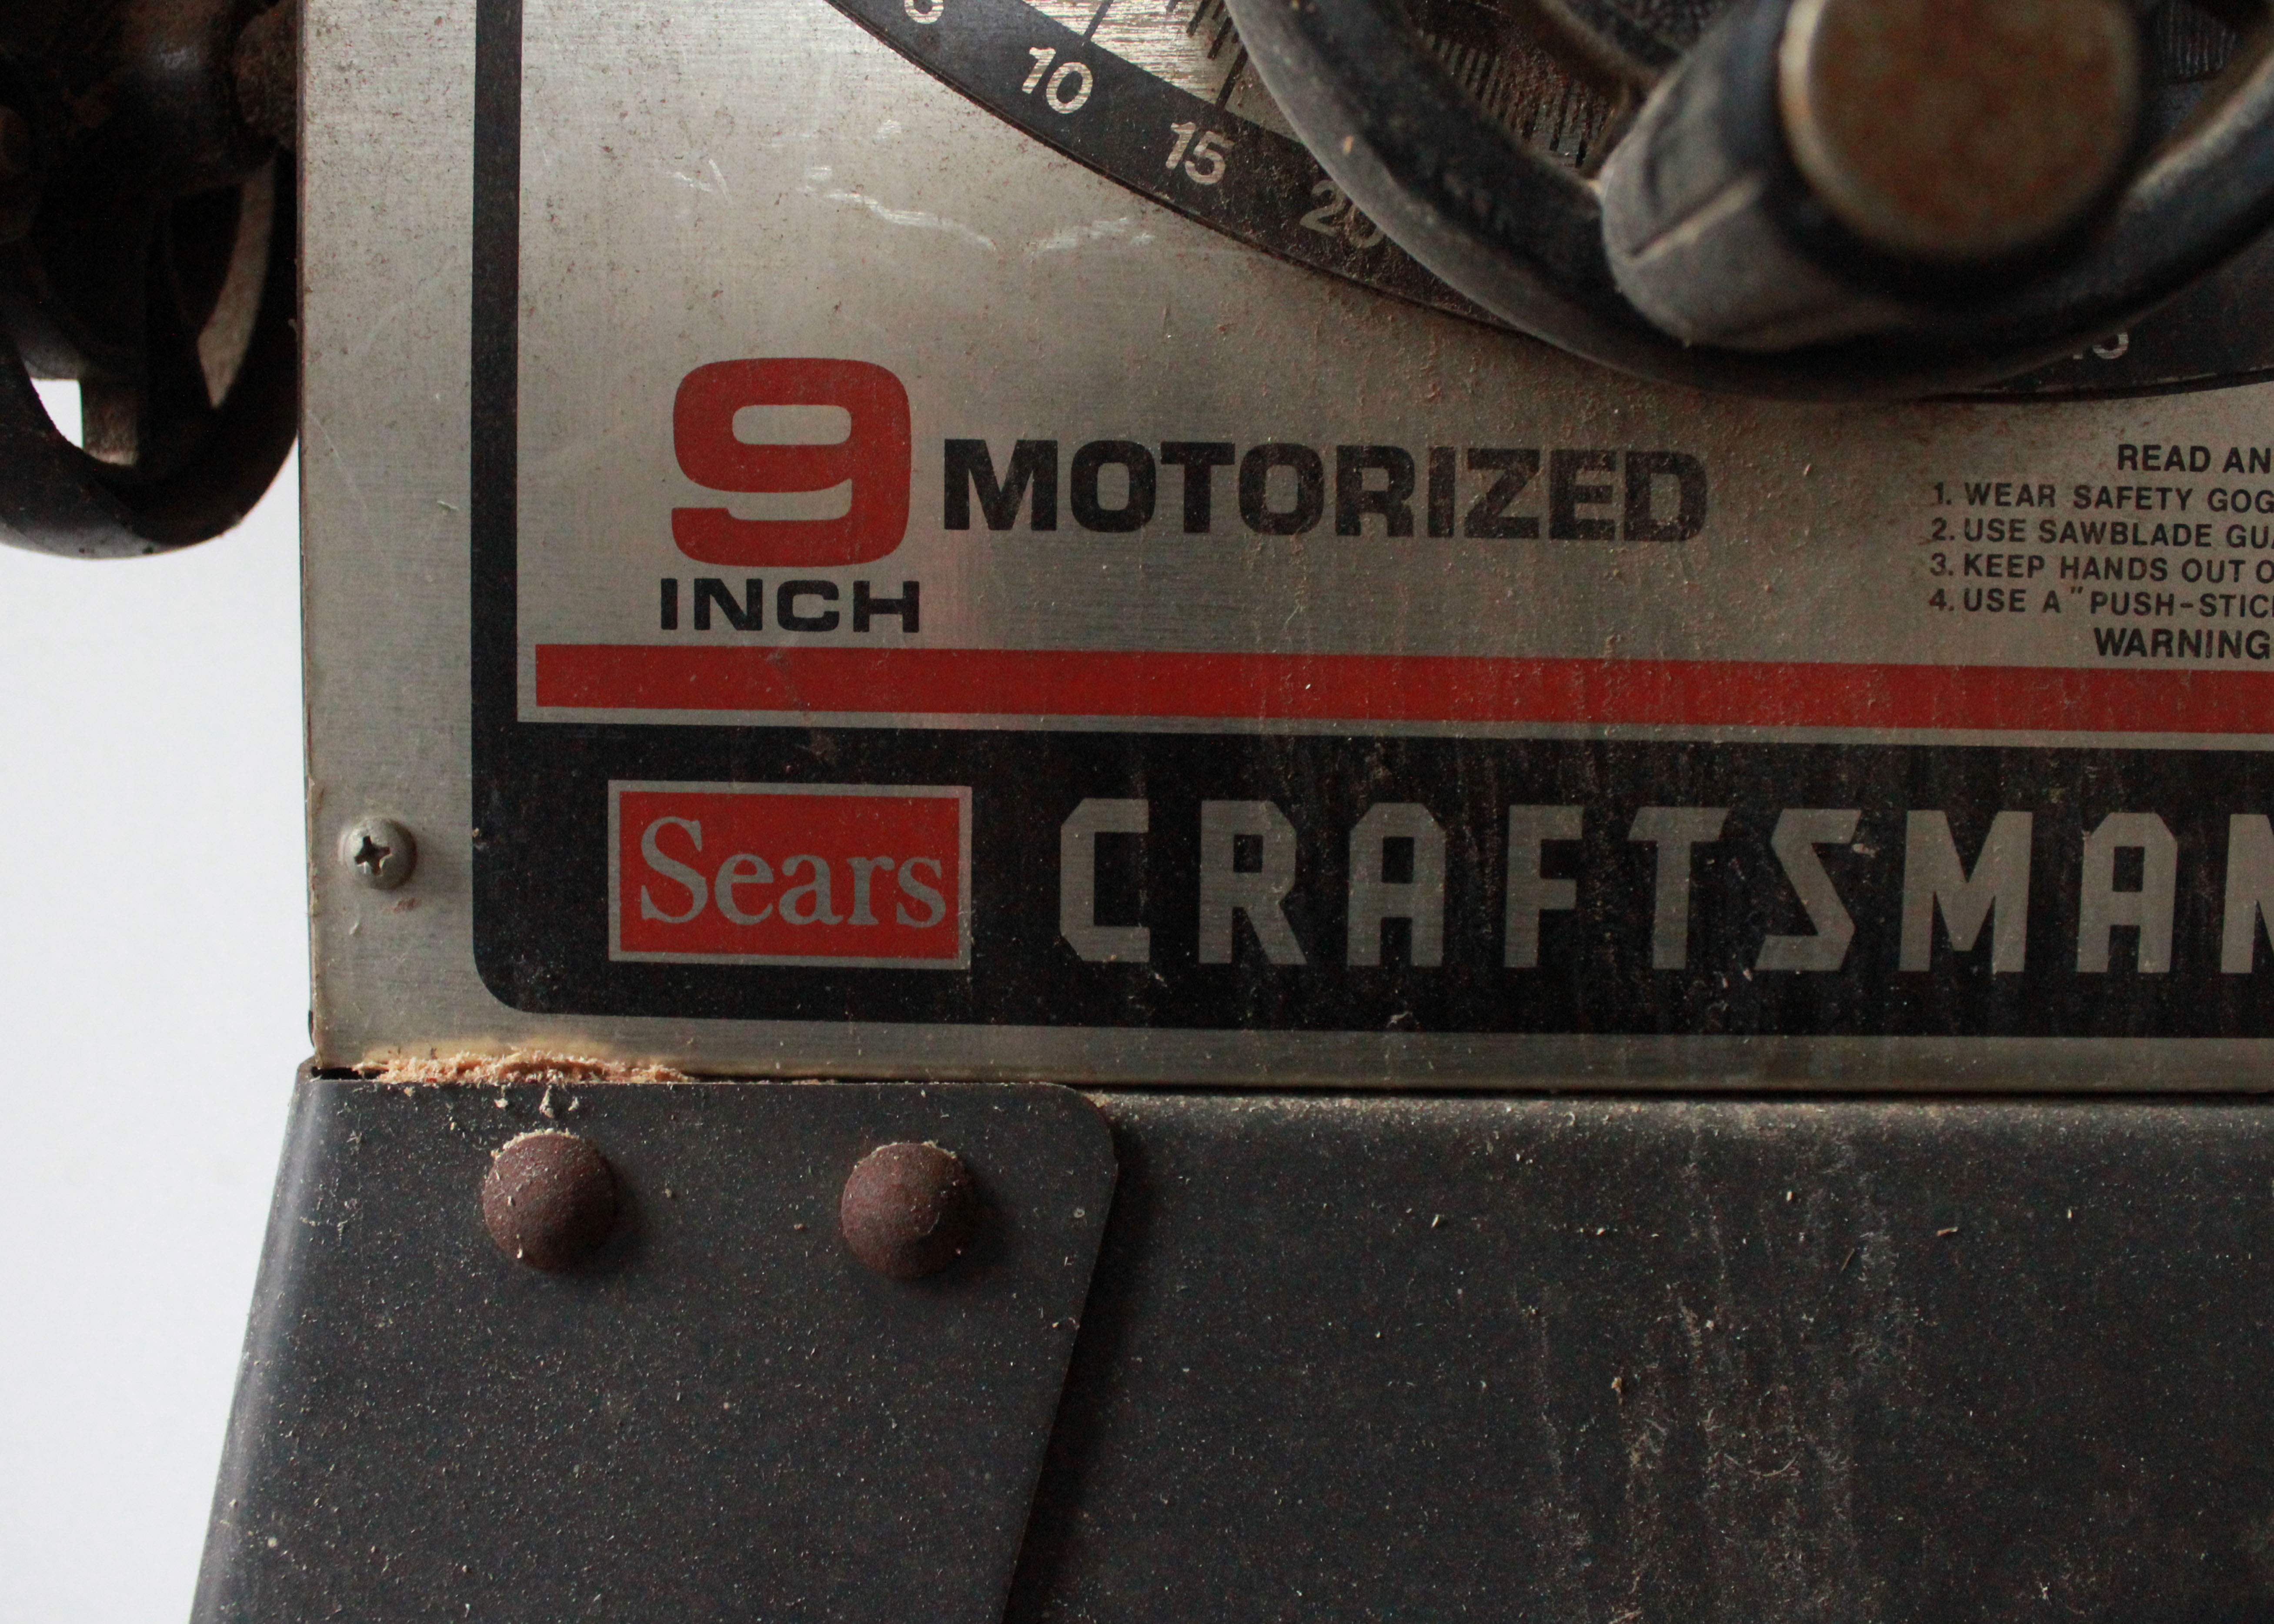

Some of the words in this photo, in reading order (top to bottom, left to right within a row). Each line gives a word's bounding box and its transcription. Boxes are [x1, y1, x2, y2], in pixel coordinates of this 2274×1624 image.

[1022, 47, 1093, 113] 10
[1166, 122, 1233, 185] 15
[671, 358, 912, 567] 9
[2118, 444, 2211, 472] READ
[944, 438, 1709, 543] MOTORIZED
[1933, 482, 1951, 505] 1.
[1964, 482, 2055, 507] WEAR
[2074, 485, 2193, 511] SAFETY
[2207, 488, 2274, 514] GOG
[1931, 517, 1955, 543] 2.
[1964, 518, 2026, 542] USE
[2039, 519, 2212, 547] SAWBLADE
[2226, 524, 2274, 549] GU
[1930, 552, 1953, 576] 3.
[1964, 553, 2044, 578] KEEP
[2060, 556, 2167, 581] HANDS
[2181, 558, 2245, 584] OUT
[661, 578, 919, 633] INCH
[1928, 588, 1954, 611] 4.
[1964, 588, 2026, 612] USE
[2042, 590, 2061, 613] A
[2070, 586, 2274, 618] "PUSH-STIC
[2094, 627, 2270, 660] WARNING
[641, 816, 946, 928] Sears
